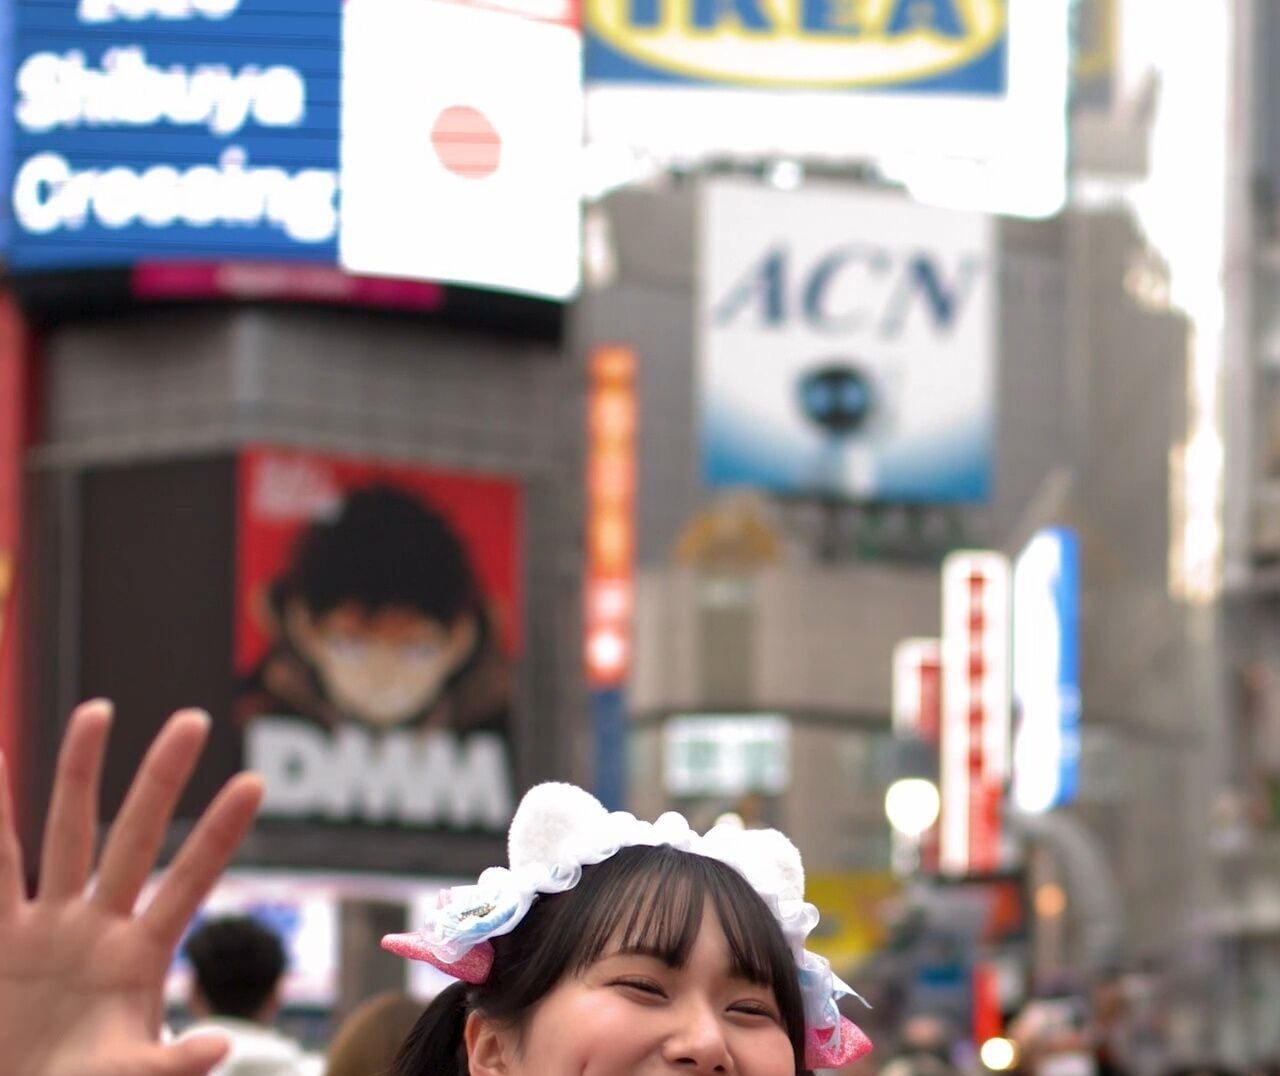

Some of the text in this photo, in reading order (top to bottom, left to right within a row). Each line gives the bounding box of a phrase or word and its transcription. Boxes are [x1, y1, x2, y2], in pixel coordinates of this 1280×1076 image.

[16, 46, 306, 134] Shibuya
[13, 146, 339, 242] Crossing
[711, 242, 982, 339] ACN
[244, 713, 513, 831] DMM
